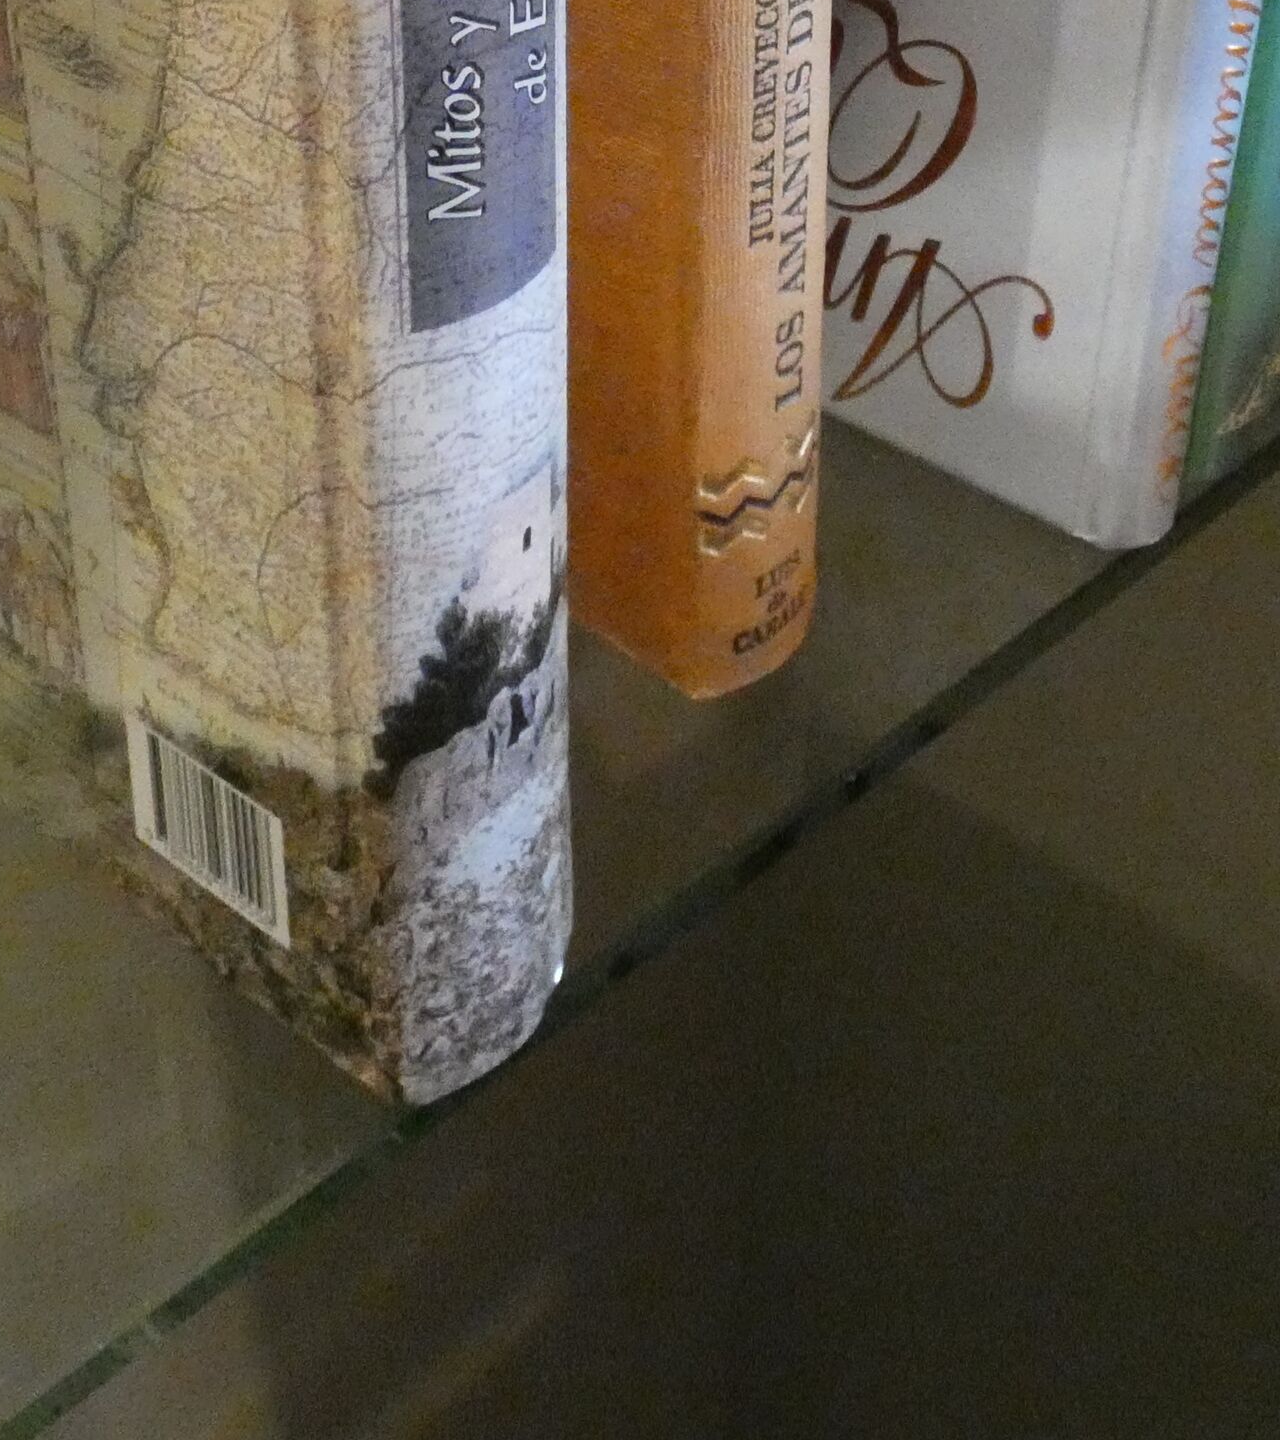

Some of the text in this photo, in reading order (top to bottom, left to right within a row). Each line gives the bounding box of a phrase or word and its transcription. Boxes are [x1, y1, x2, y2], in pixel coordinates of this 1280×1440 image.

[449, 14, 499, 46] y
[513, 49, 548, 105] de
[426, 63, 486, 222] Mitos
[778, 60, 813, 295] AMANTES
[749, 148, 776, 248] JULIA
[775, 310, 805, 413] LOS
